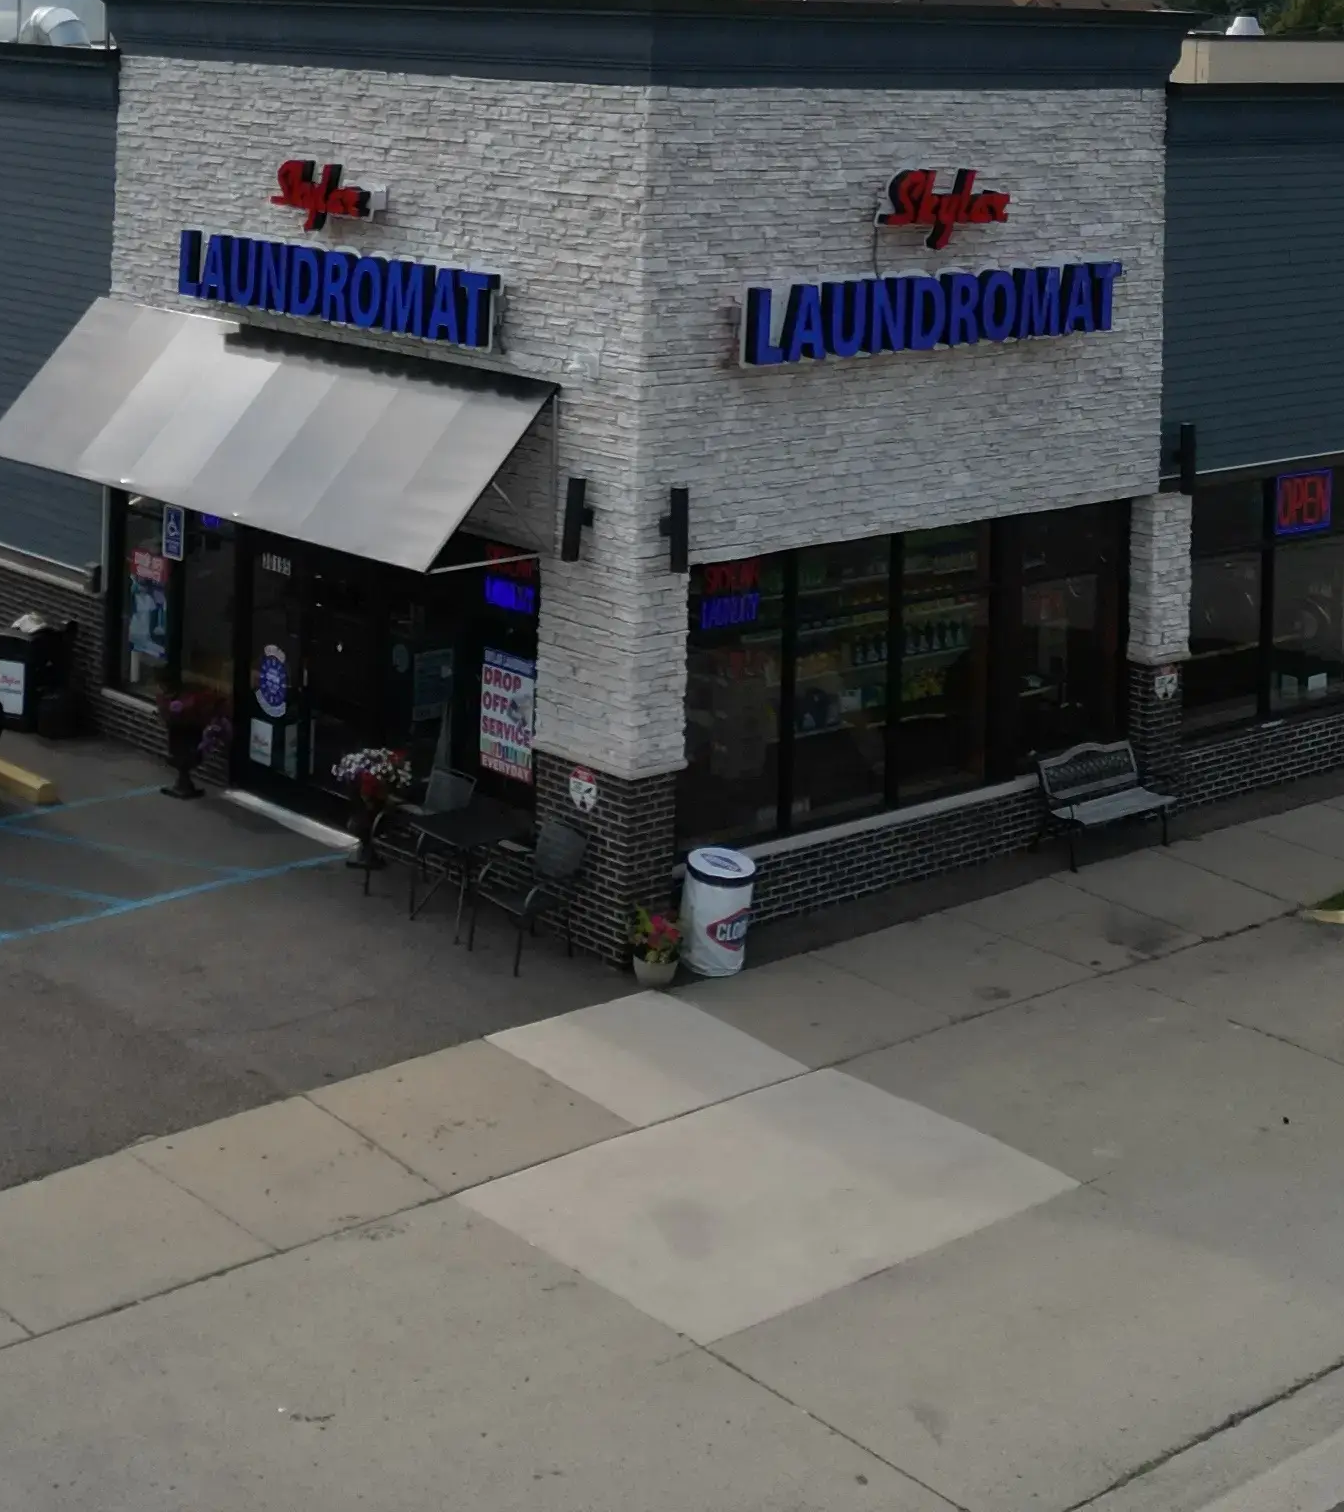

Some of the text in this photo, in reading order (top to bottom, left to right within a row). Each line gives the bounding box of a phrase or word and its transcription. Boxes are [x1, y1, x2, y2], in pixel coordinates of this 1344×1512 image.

[178, 229, 502, 348] LAUNDROMAT
[747, 261, 1122, 365] LAUNDROMAT
[1278, 476, 1329, 527] OPEN
[483, 666, 522, 694] DROP
[482, 691, 508, 715] OFF
[482, 715, 532, 748] SERVICE
[482, 754, 529, 782] EVERYDAY
